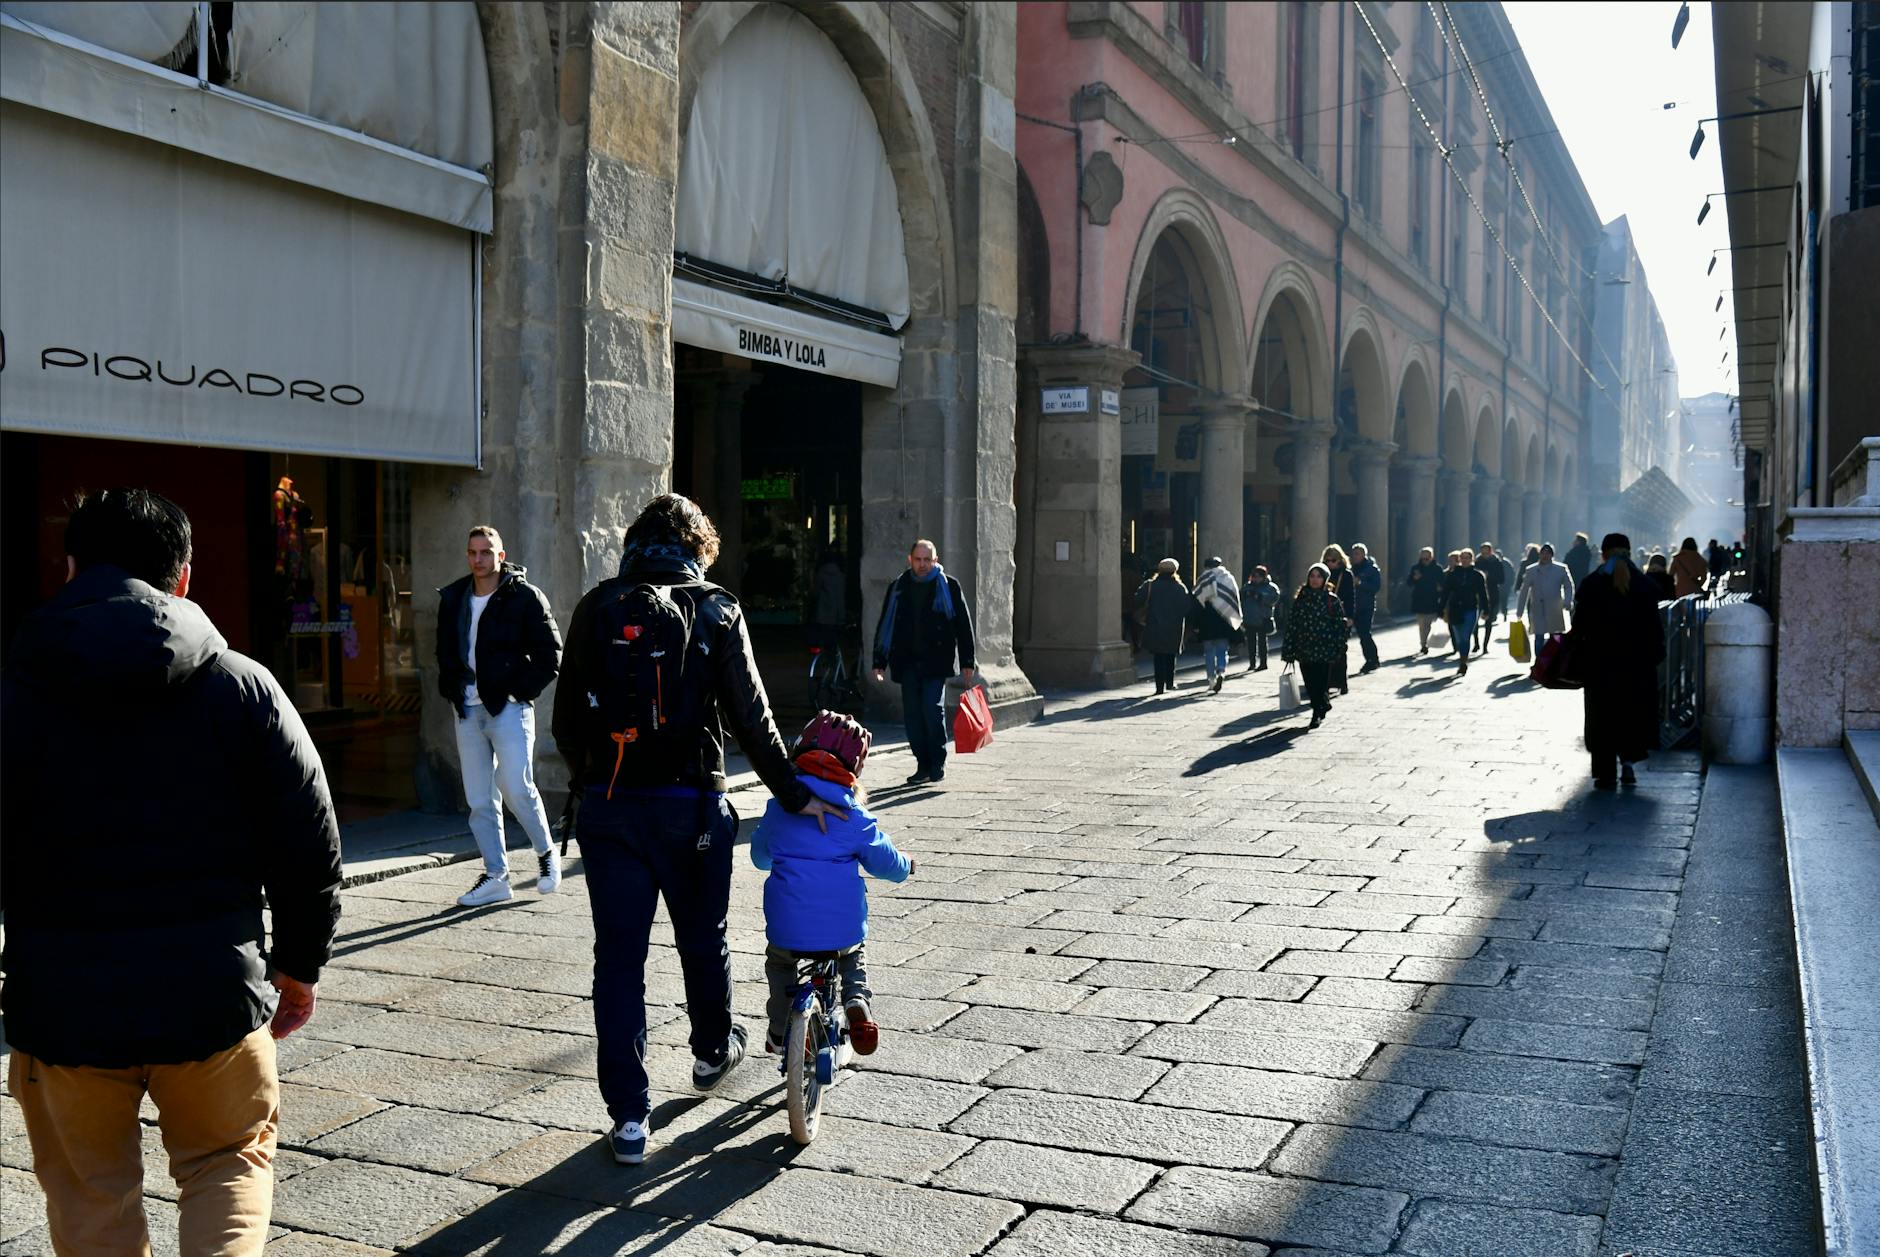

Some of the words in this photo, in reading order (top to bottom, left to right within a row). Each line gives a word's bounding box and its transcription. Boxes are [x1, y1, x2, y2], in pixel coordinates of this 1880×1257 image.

[739, 329, 782, 358] BIMBA
[784, 339, 793, 360] Y
[795, 342, 826, 368] LOLA
[41, 347, 364, 406] PIQUADRO
[1058, 392, 1072, 400] VIA
[1061, 400, 1085, 409] MUSEI
